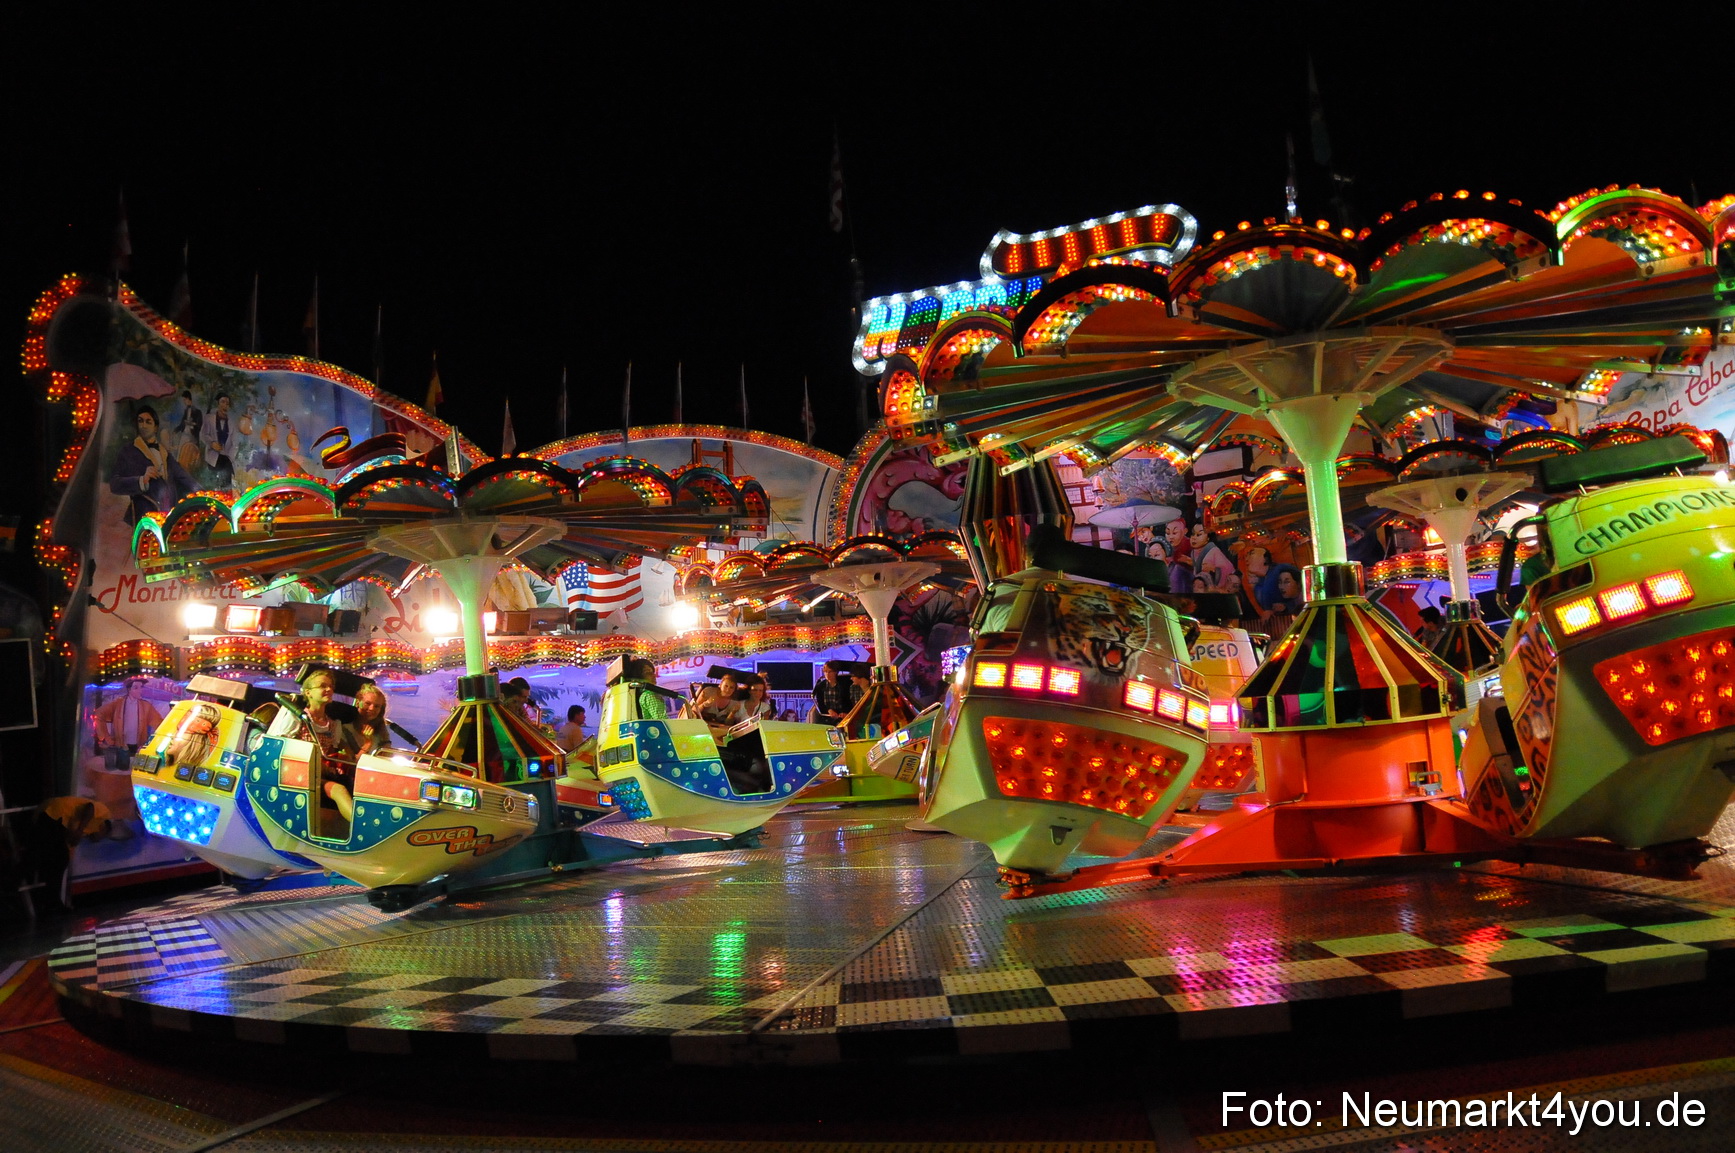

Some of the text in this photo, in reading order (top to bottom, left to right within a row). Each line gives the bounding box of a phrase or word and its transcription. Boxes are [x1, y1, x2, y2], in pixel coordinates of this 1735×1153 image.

[1685, 359, 1735, 407] Caba
[1574, 490, 1735, 555] CHAMPIONS
[97, 574, 263, 614] Montmart
[413, 828, 470, 844] OVER
[453, 837, 488, 851] THE
